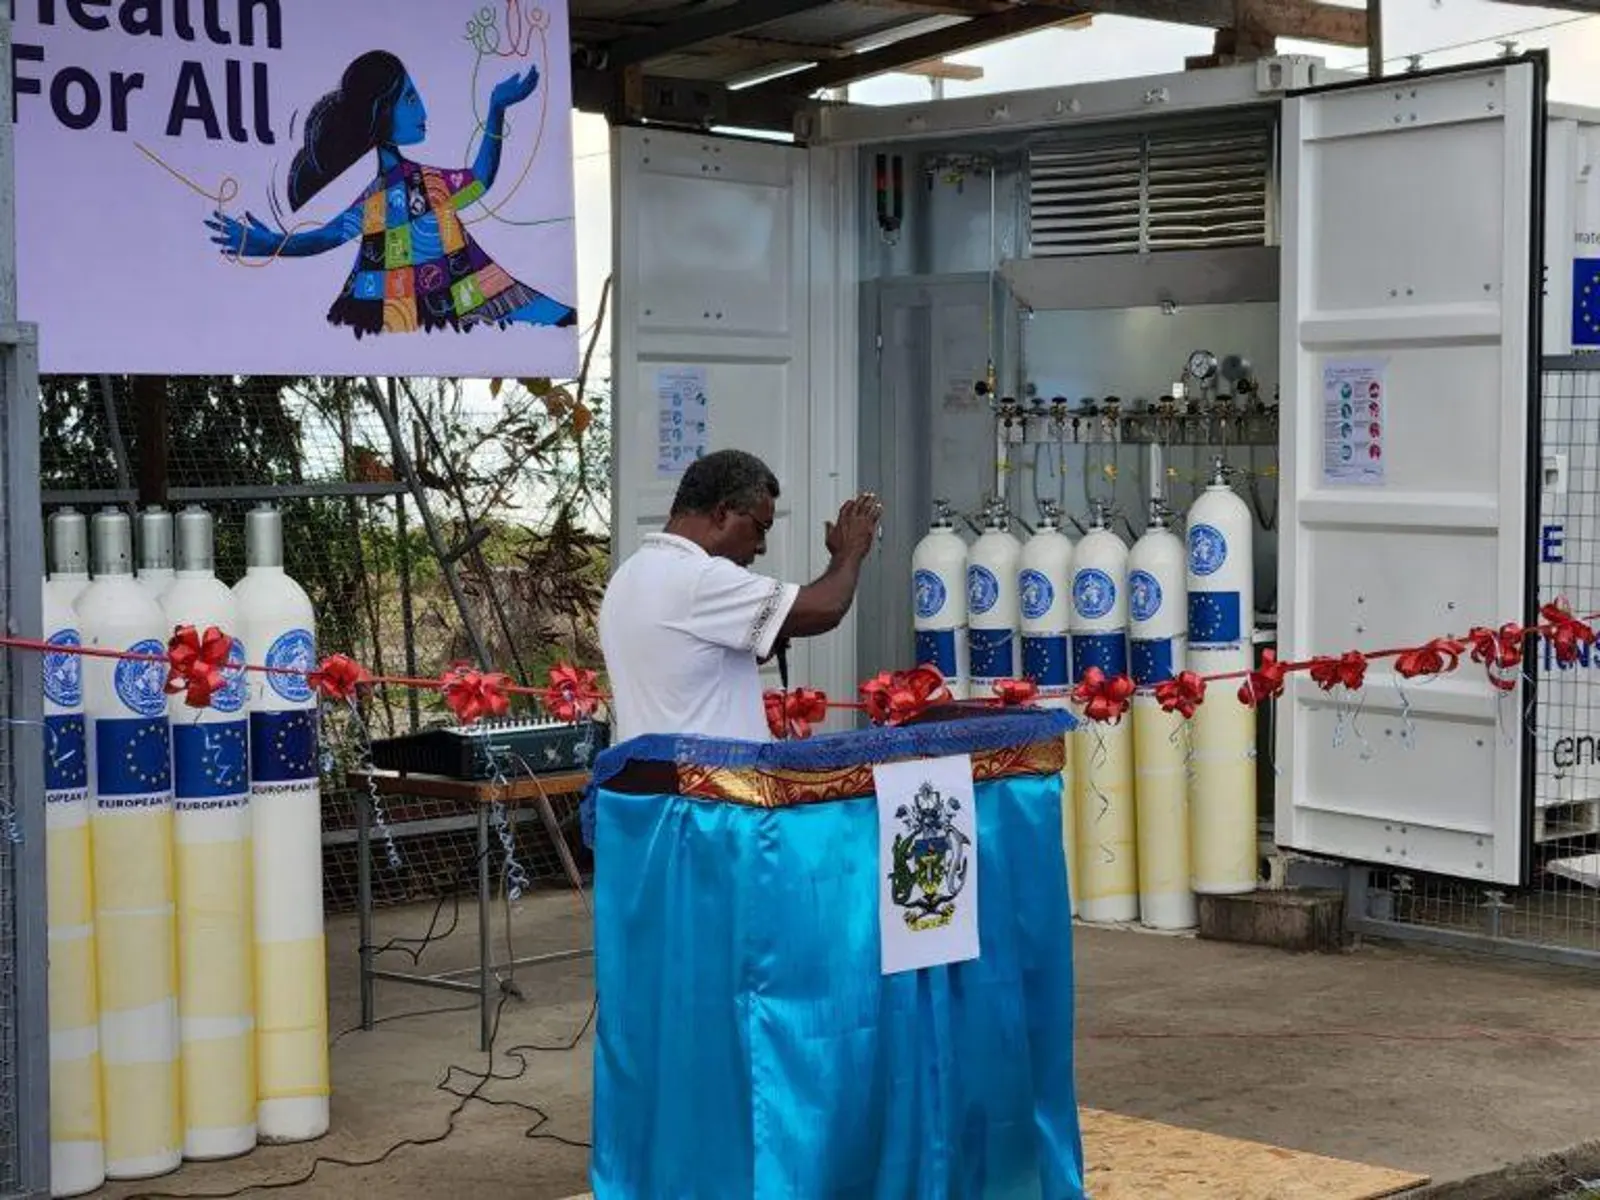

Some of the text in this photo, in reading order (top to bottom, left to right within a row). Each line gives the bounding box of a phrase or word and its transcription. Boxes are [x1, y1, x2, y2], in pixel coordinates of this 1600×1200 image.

[11, 43, 276, 145] For All
[98, 797, 163, 809] EUROPEAN
[175, 800, 238, 811] EUROPEAN
